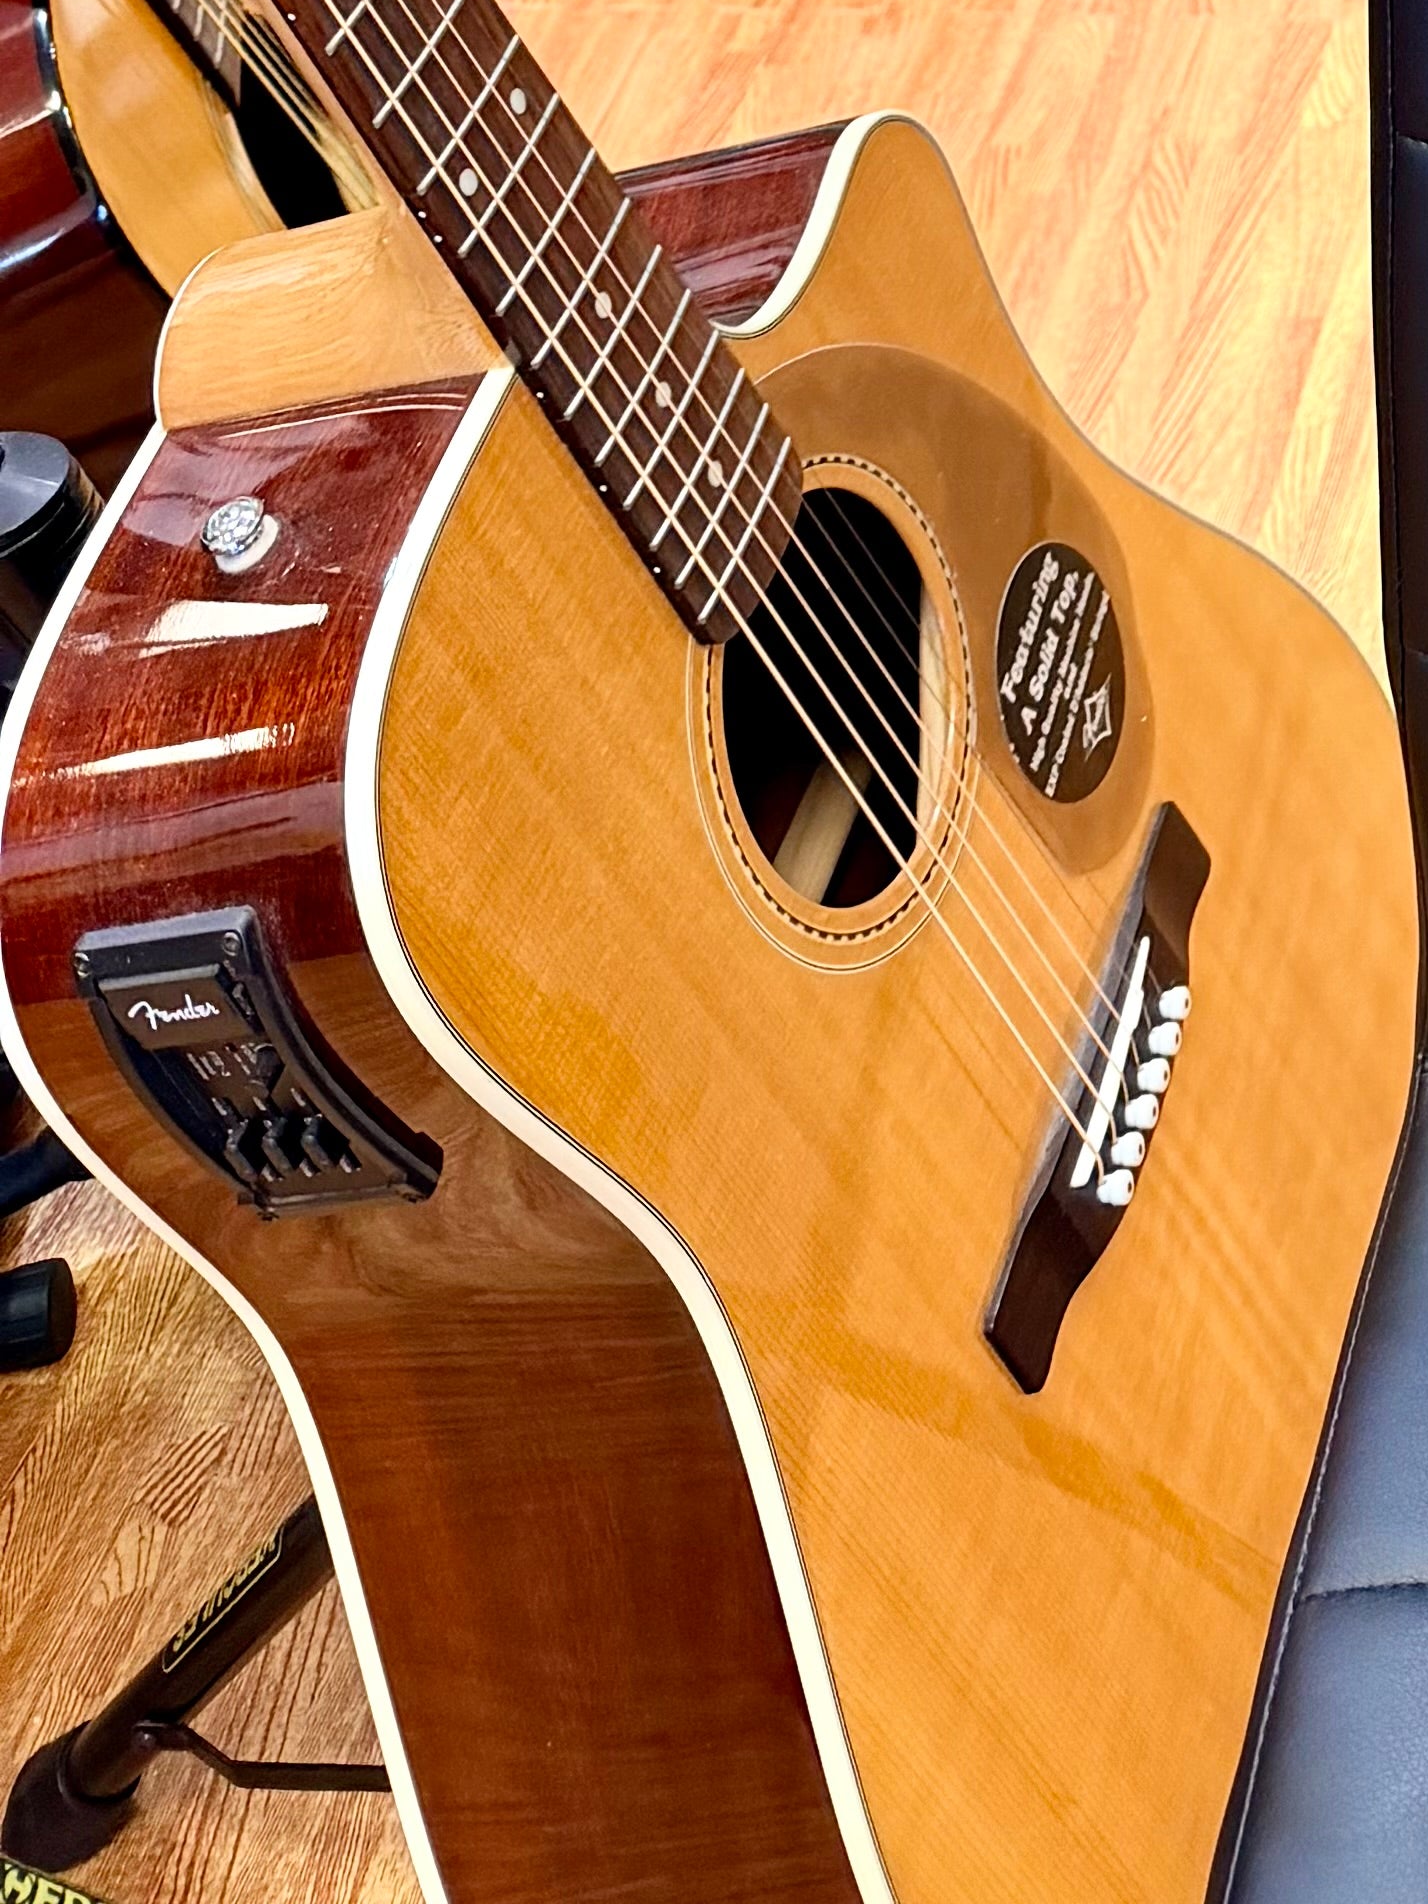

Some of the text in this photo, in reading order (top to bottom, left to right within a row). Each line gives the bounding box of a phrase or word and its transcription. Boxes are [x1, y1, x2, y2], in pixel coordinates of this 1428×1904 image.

[1000, 550, 1060, 704] Featuring
[1028, 627, 1060, 703] Solid
[1020, 705, 1037, 737] A
[127, 993, 221, 1032] Fender
